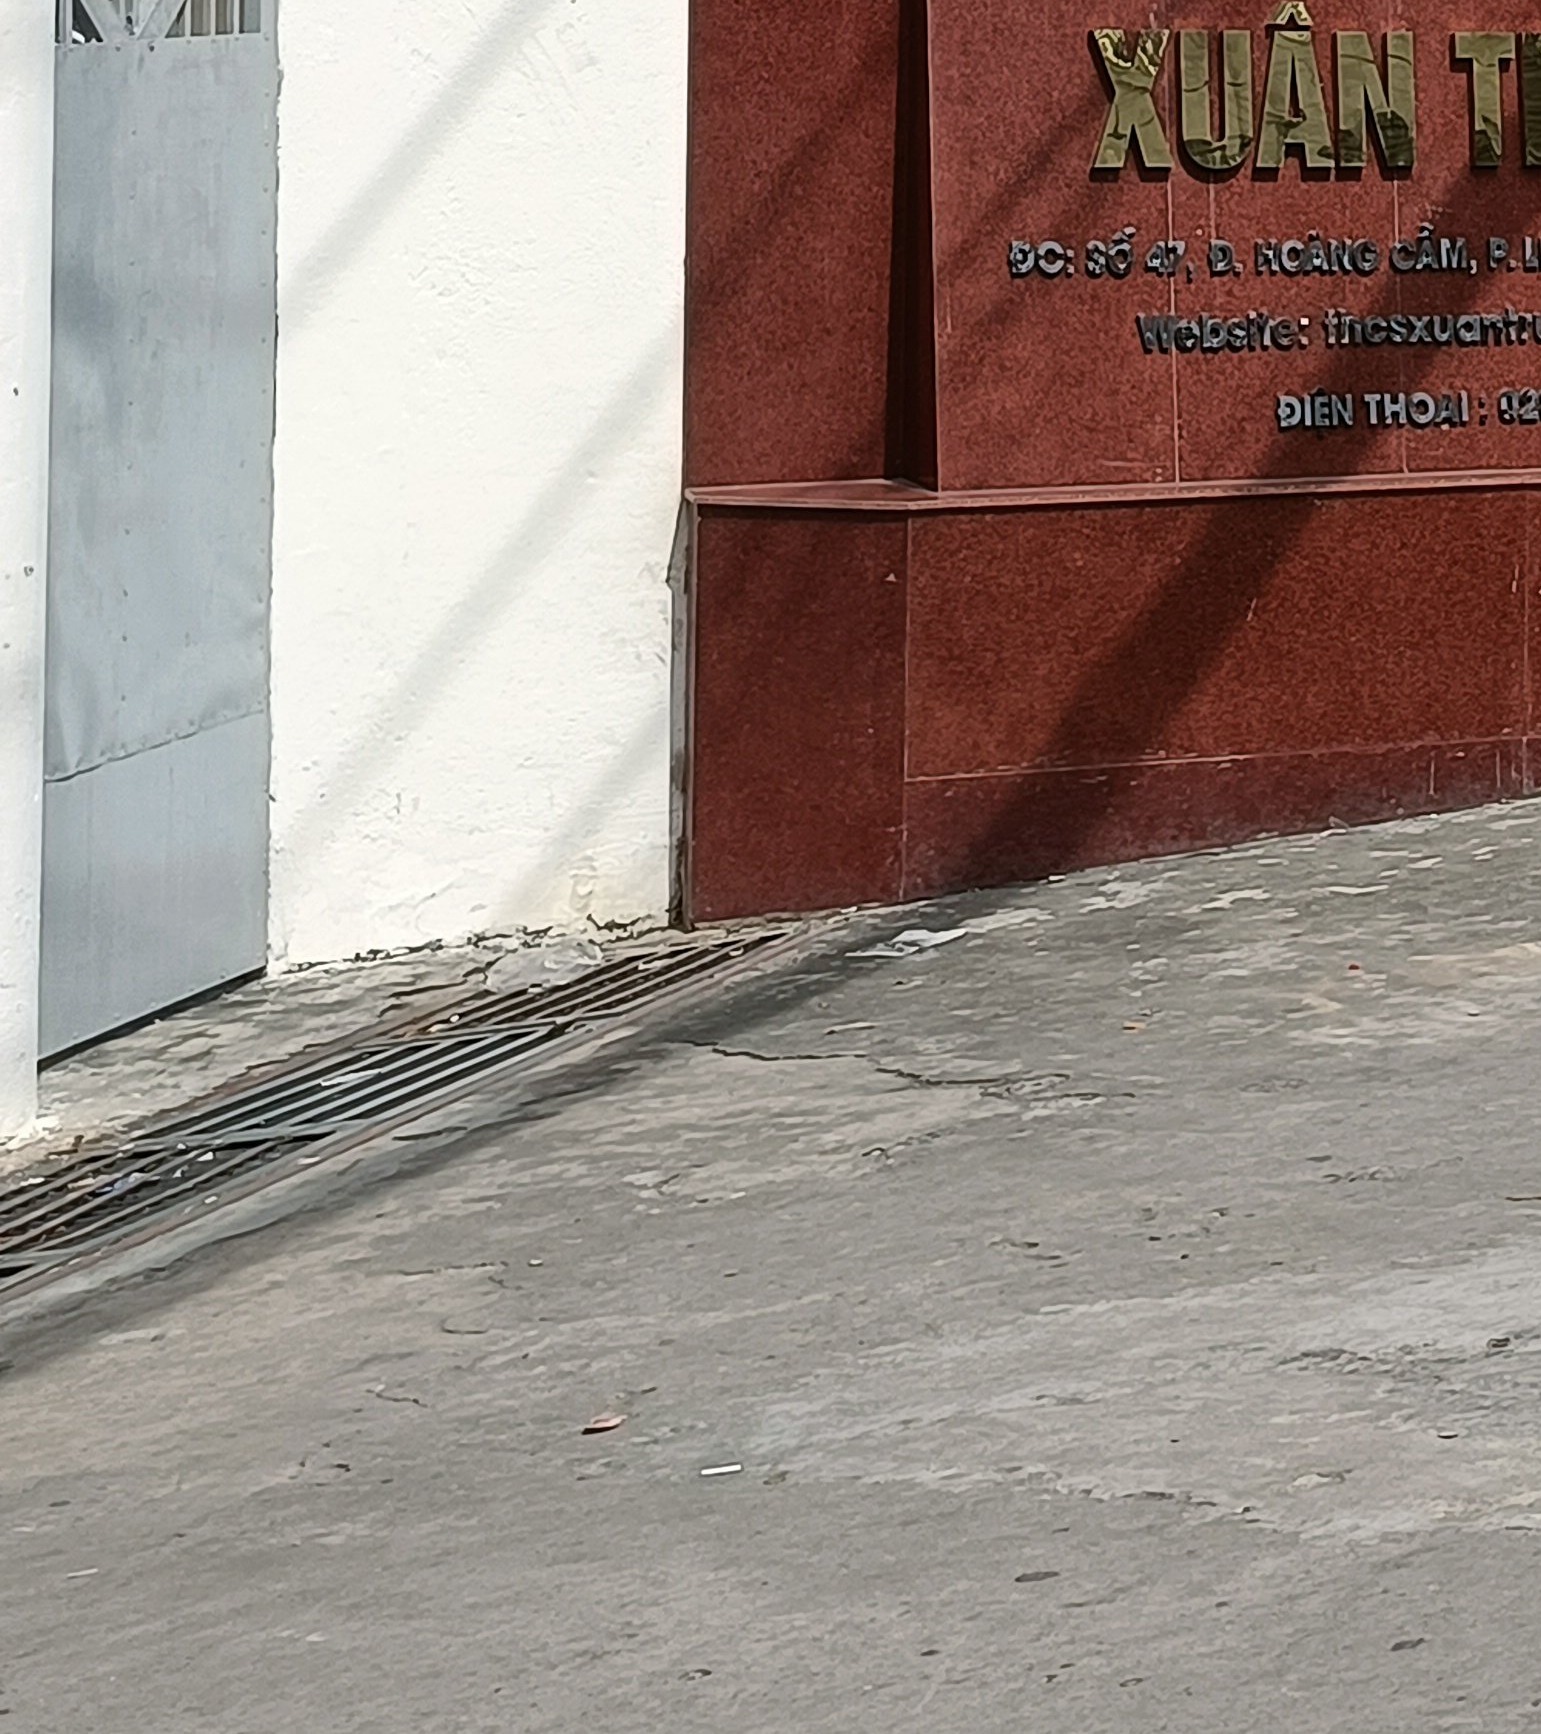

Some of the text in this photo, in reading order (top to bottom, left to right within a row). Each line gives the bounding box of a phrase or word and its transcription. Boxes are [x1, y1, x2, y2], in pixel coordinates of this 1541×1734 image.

[1094, 1, 1418, 170] XUÂN
[1086, 225, 1137, 276] SỐ
[1254, 229, 1379, 272] HOÀNG
